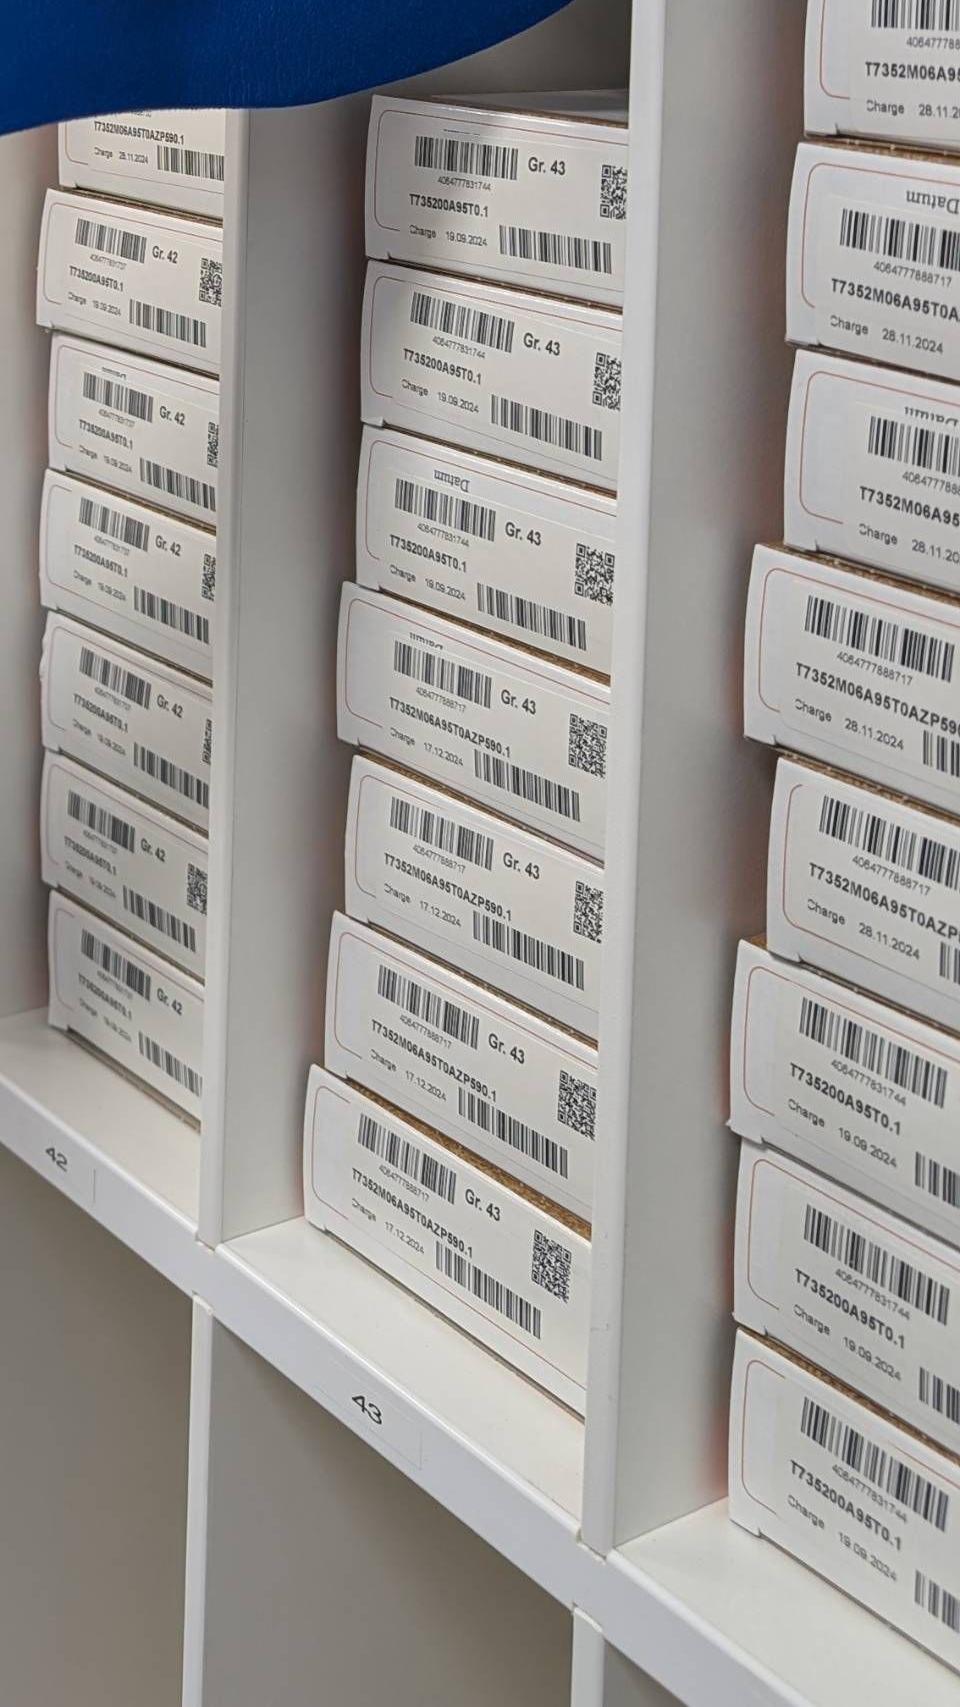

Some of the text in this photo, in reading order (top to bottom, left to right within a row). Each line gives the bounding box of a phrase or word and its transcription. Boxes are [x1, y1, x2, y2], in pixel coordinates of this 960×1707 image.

[866, 100, 905, 117] Charge
[528, 156, 566, 176] Gr. 43
[409, 194, 489, 218] T735200A95T0.1
[409, 224, 488, 248] Charge 19.09.2024
[152, 245, 178, 264] Gr. 42
[831, 278, 960, 323] T7352M06A95T0A
[523, 333, 561, 356] Gr. 43
[830, 315, 944, 354] Charge 28.11.2024
[403, 348, 482, 385] T735200A95T0.1
[401, 378, 480, 414] Charge 19.09.2024
[159, 406, 185, 426] Gr. 42
[434, 469, 471, 493] Datum
[155, 535, 182, 557] Gr. 42
[505, 522, 542, 546] Gr. 43
[859, 523, 898, 545] Charge
[389, 534, 467, 573] T735200A95T0.1
[389, 564, 466, 601] Charge 19.09.2024
[156, 694, 183, 718] Gr. 42
[500, 689, 537, 715] Gr. 43
[389, 696, 511, 758] T7352M06A95T0AZP590.1
[389, 727, 416, 747] Charge
[795, 698, 905, 750] Charge 28.11.2024
[140, 837, 152, 856] Gr.
[155, 844, 166, 862] 42
[503, 852, 540, 880] Gr. 43
[384, 853, 512, 921] T7352M06A95T0AZP590.1
[384, 882, 412, 904] Charge
[809, 862, 960, 943] T7352M06A95T0AZP
[807, 898, 921, 960] Charge 28.11.2024
[156, 988, 183, 1015] Gr. 42
[370, 1049, 397, 1072] Charge
[371, 1019, 497, 1101] T7352M06A95T0AZP590.1
[488, 1032, 525, 1064] Gr. 43
[790, 1062, 902, 1135] T735200A95T0.1
[788, 1098, 897, 1169] Charge 19.09.2024
[45, 1145, 68, 1172] 42
[351, 1197, 377, 1222] Charge
[351, 1167, 473, 1259] T7352M06A95T0AZP590.1
[464, 1188, 501, 1222] Gr. 43
[795, 1268, 905, 1349] T735200A95T0.1
[793, 1304, 902, 1381] Charge 19.09.2024
[351, 1394, 384, 1426] 43
[790, 1459, 902, 1551] T735200A95T0.1
[787, 1494, 897, 1582] Charge 19.09.2024
